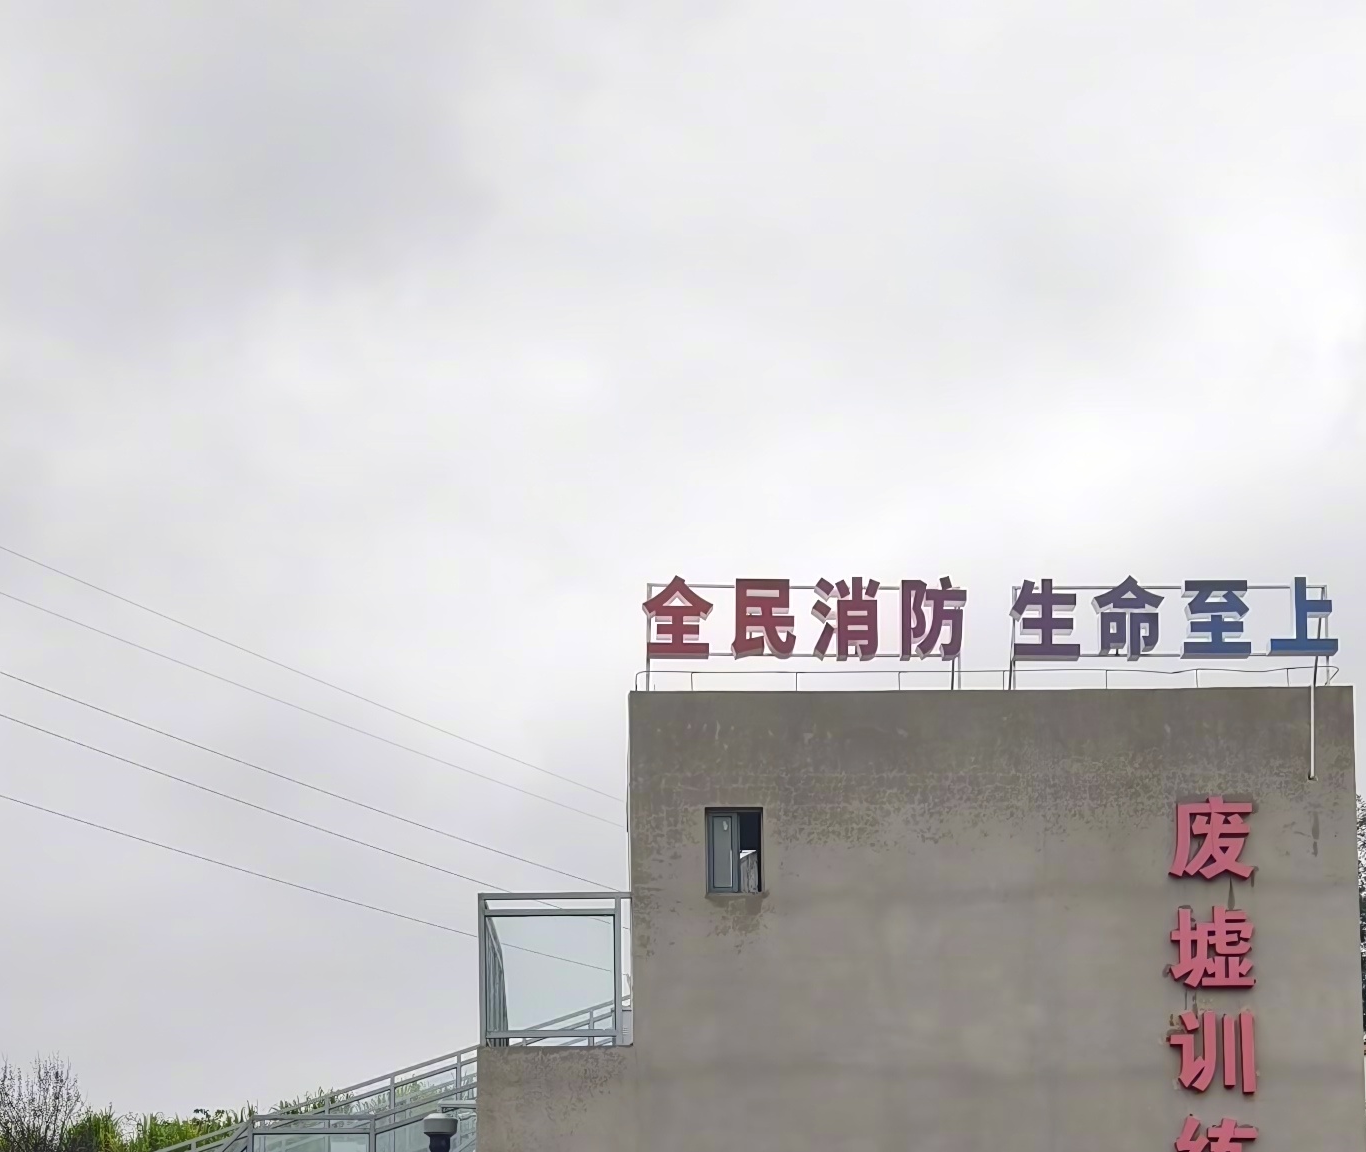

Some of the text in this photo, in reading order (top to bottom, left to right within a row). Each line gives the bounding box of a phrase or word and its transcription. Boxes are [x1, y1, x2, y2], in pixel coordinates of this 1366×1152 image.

[642, 574, 1339, 662] 全民消防 生命至上
